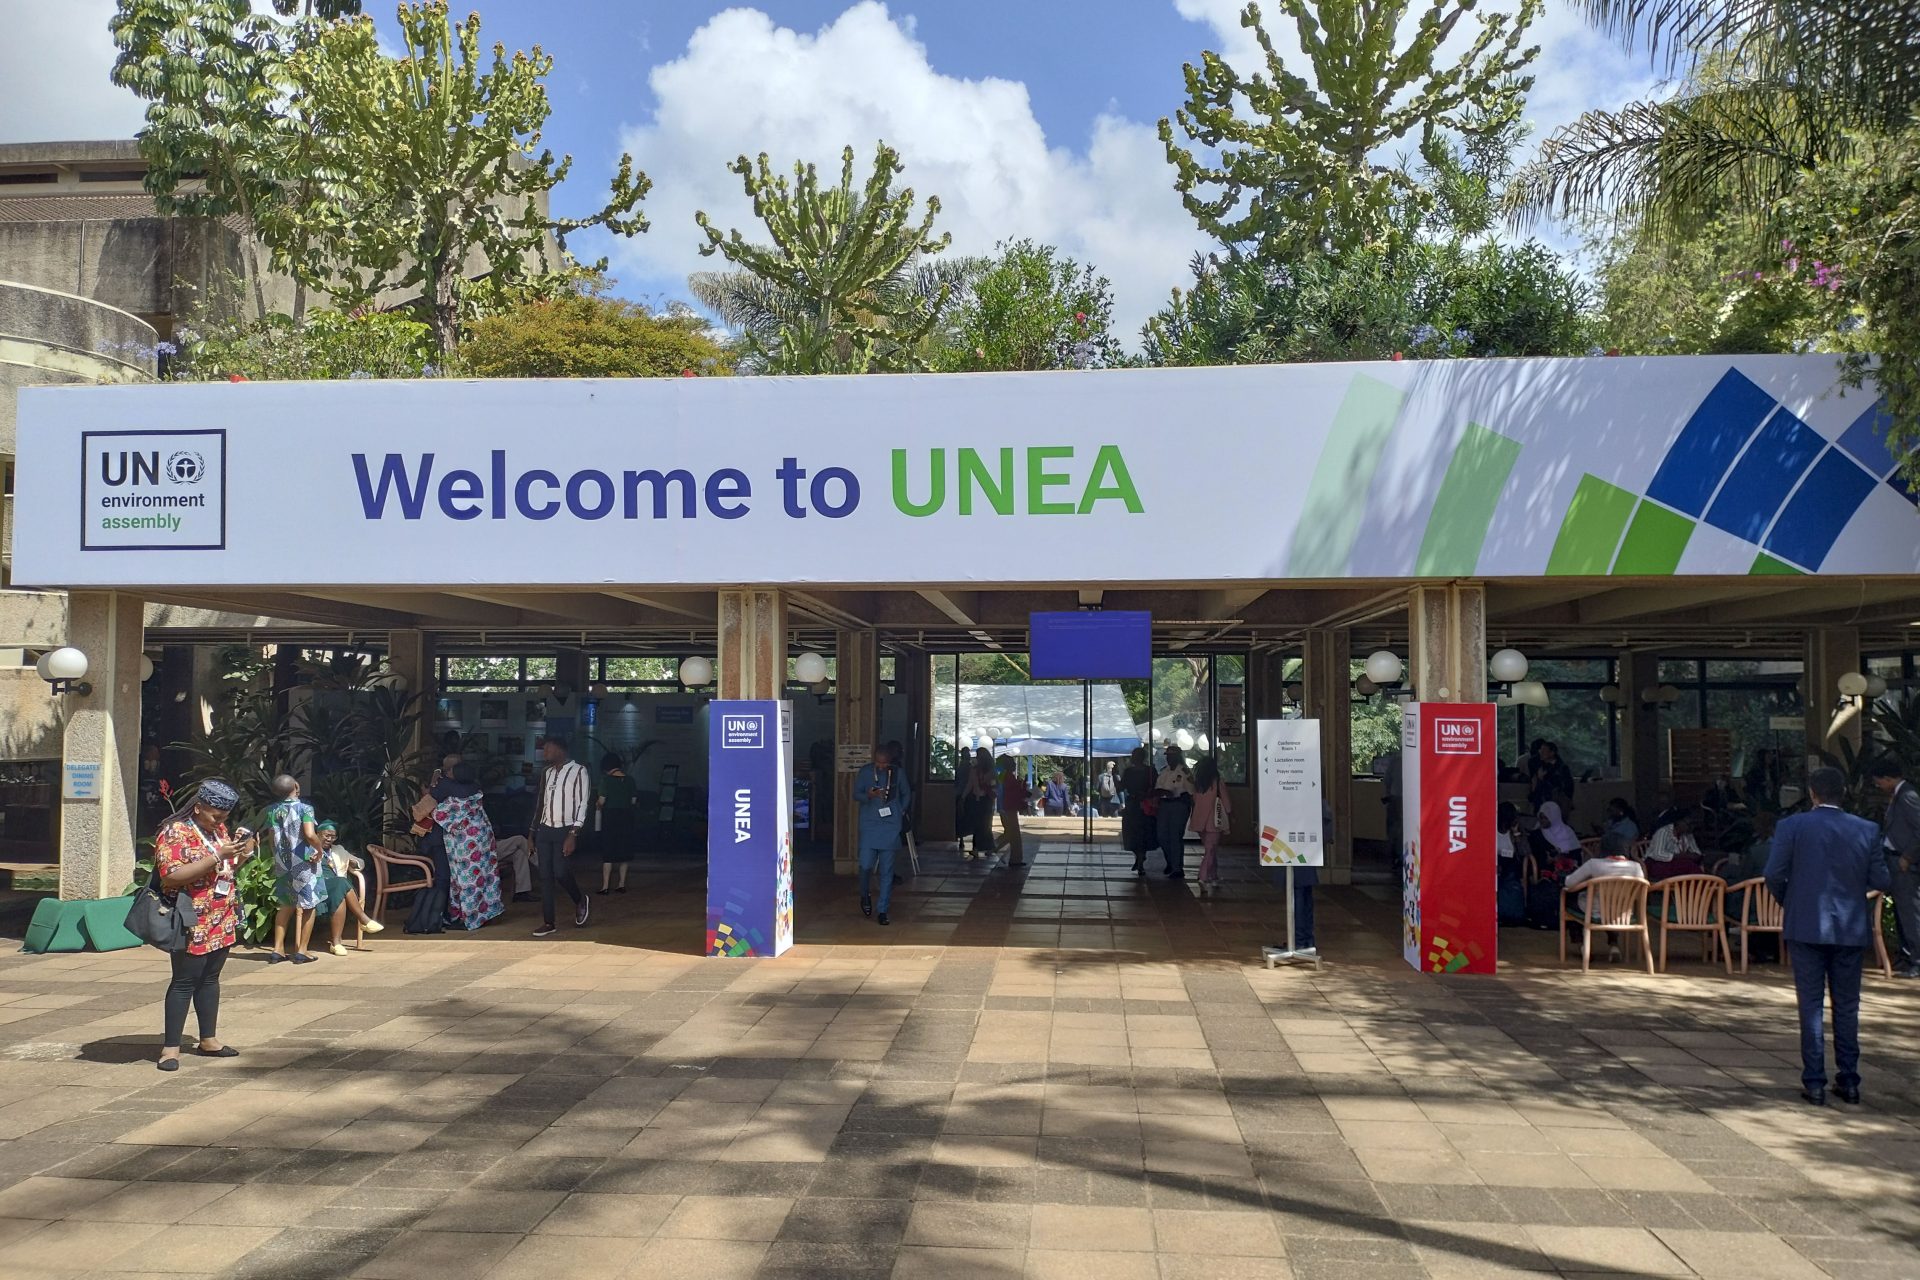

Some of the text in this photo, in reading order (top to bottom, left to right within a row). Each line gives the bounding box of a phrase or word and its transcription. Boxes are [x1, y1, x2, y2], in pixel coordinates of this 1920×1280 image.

[102, 451, 159, 486] UN
[351, 445, 1145, 521] Welcome to UNEA
[101, 492, 205, 508] environment
[102, 512, 181, 532] assembly
[728, 720, 746, 731] UN
[1441, 724, 1460, 735] UN
[734, 788, 751, 844] UNEA
[1448, 796, 1467, 853] UNEA
